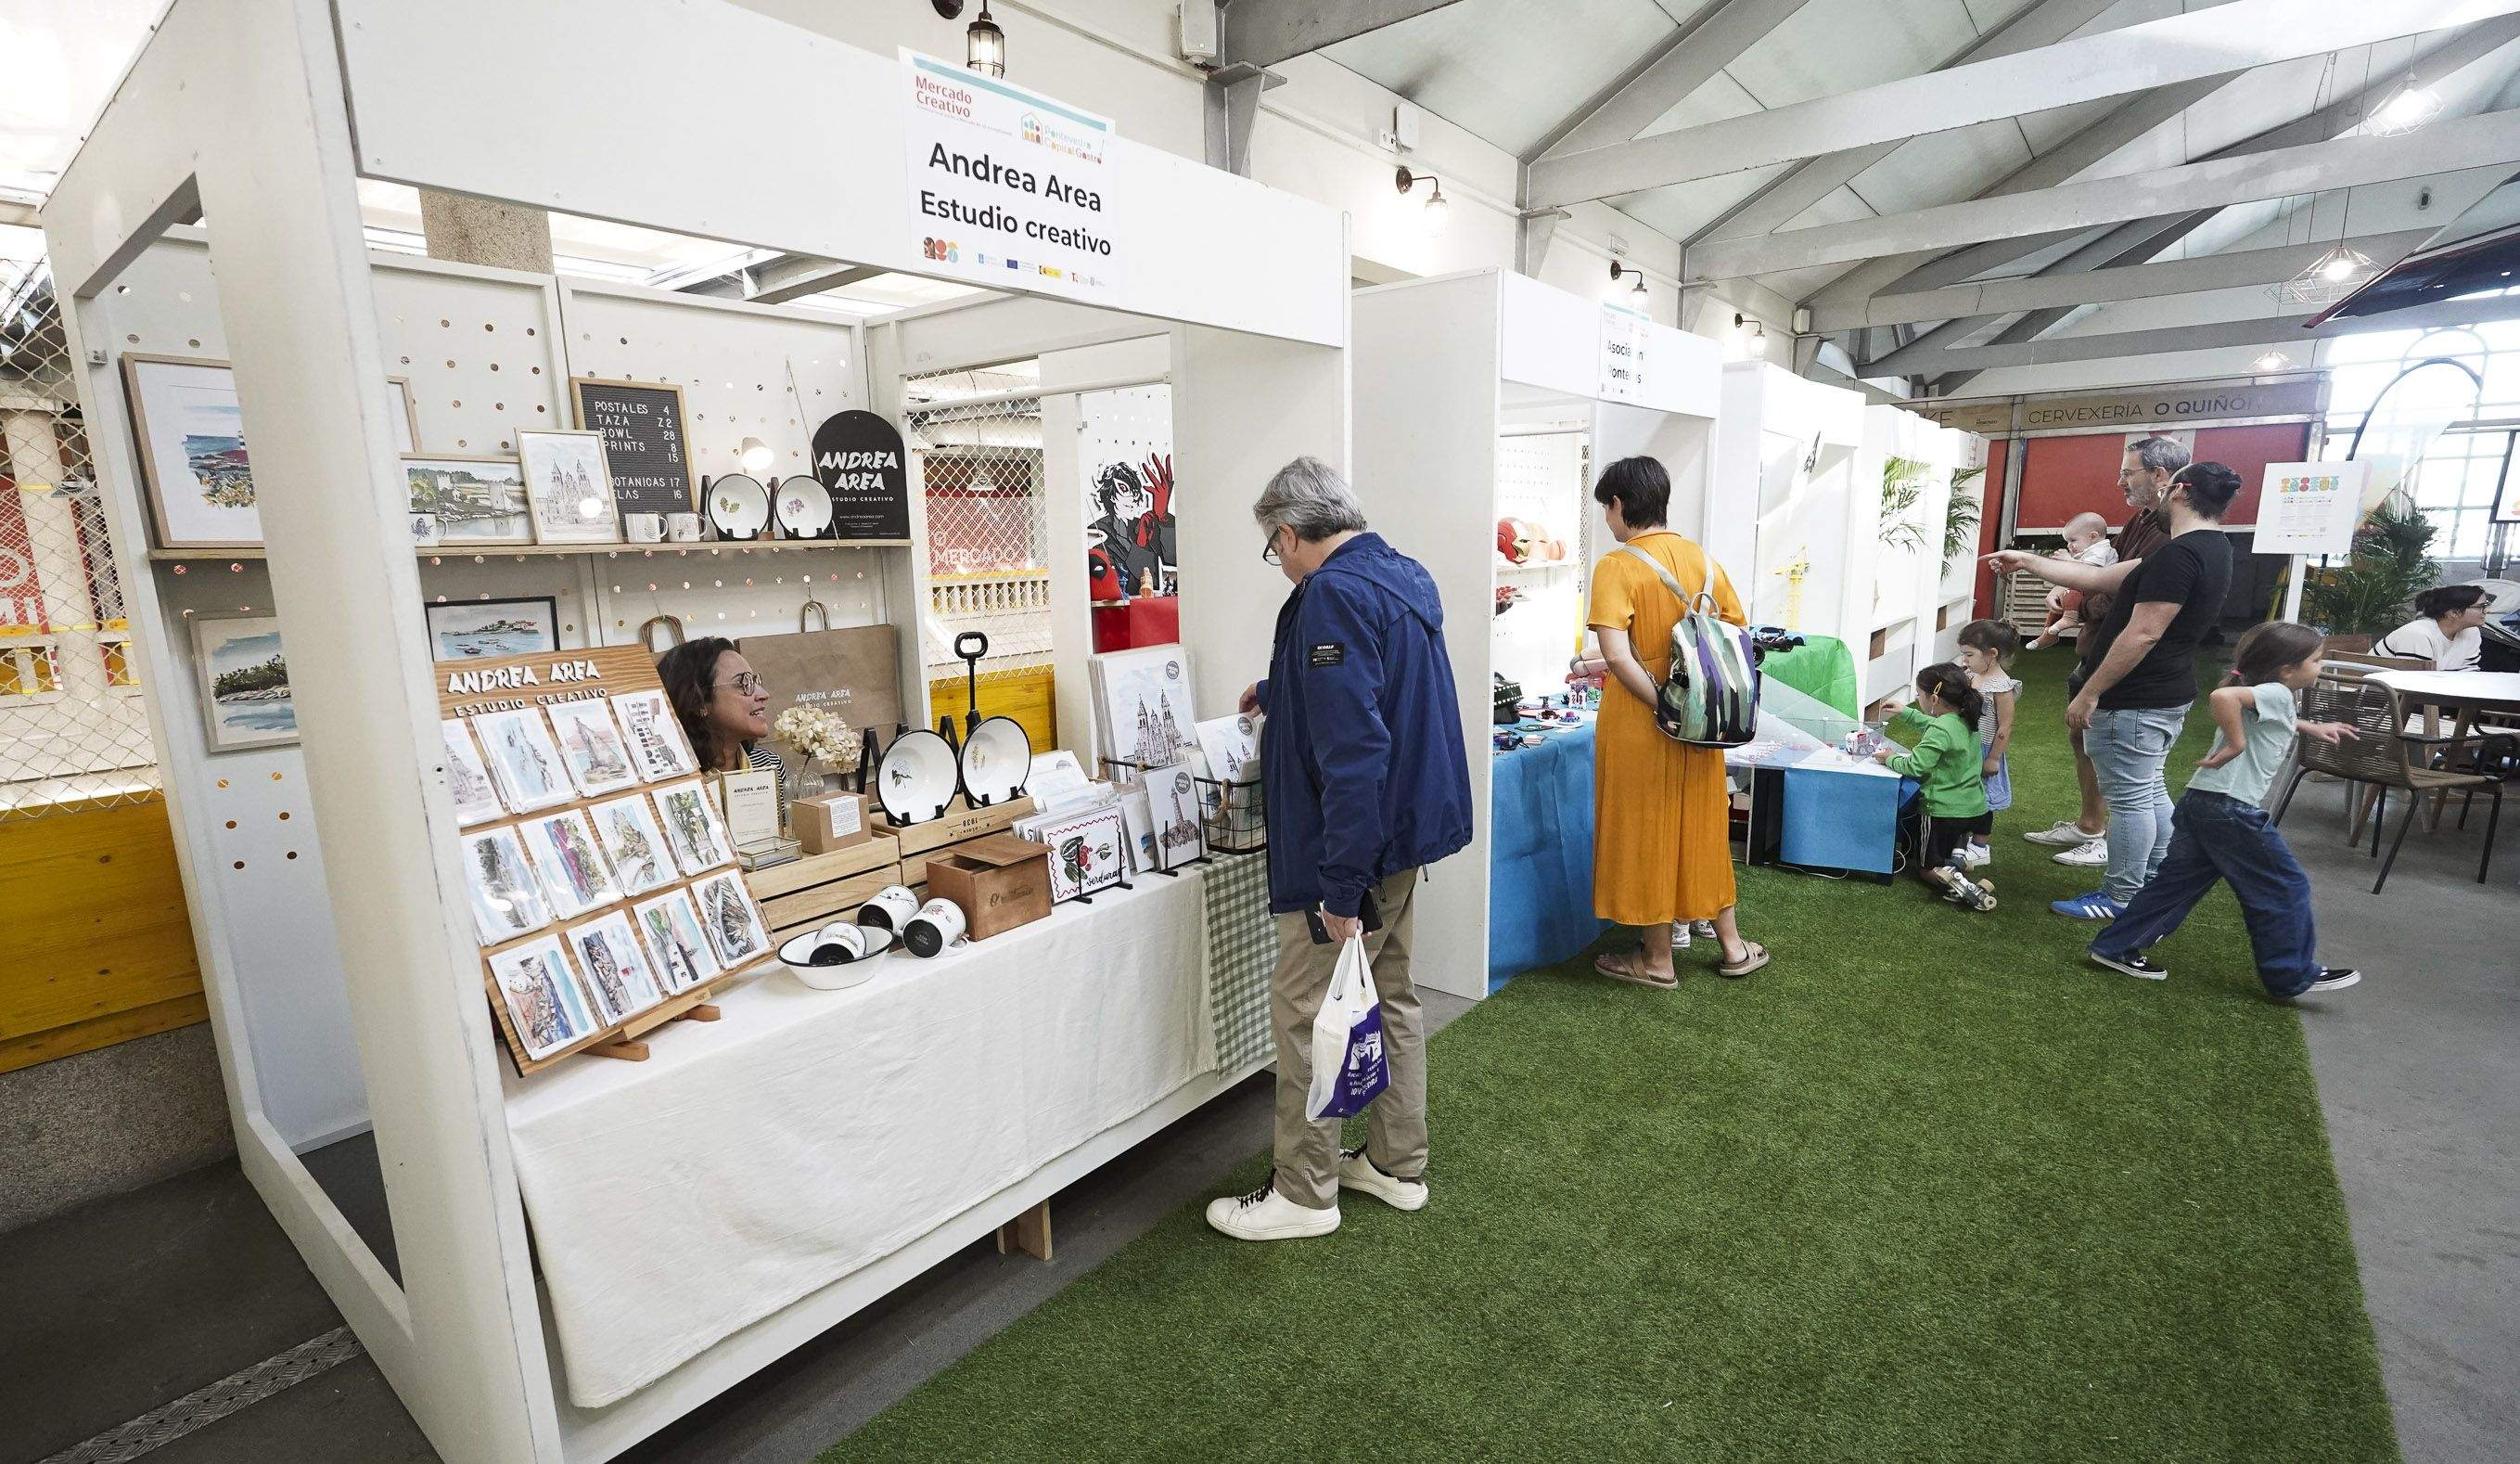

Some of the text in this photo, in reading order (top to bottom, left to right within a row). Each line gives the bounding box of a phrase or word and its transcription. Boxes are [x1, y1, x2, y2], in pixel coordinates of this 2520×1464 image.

[915, 74, 972, 104] Mercado
[916, 91, 970, 118] Creativo
[928, 142, 1101, 212] Andrea Area
[921, 189, 1111, 256] Estudio creativo
[595, 401, 670, 415] POSTALES 4
[2028, 401, 2143, 424] CERVEXERÍA
[2155, 402, 2170, 416] O
[596, 414, 630, 426] TAZA
[600, 428, 675, 441] BOWL 28
[604, 441, 677, 453] PRINTS 8
[668, 454, 679, 463] 15
[818, 450, 899, 470] ANDREA
[670, 478, 680, 487] 17
[834, 471, 886, 491] AREA
[673, 489, 683, 500] 16
[447, 659, 601, 695] ANDREA AREA
[455, 687, 608, 718] ESTUDIO CREATIVO
[795, 688, 851, 702] ANDREA AREA
[962, 816, 979, 828] 1938
